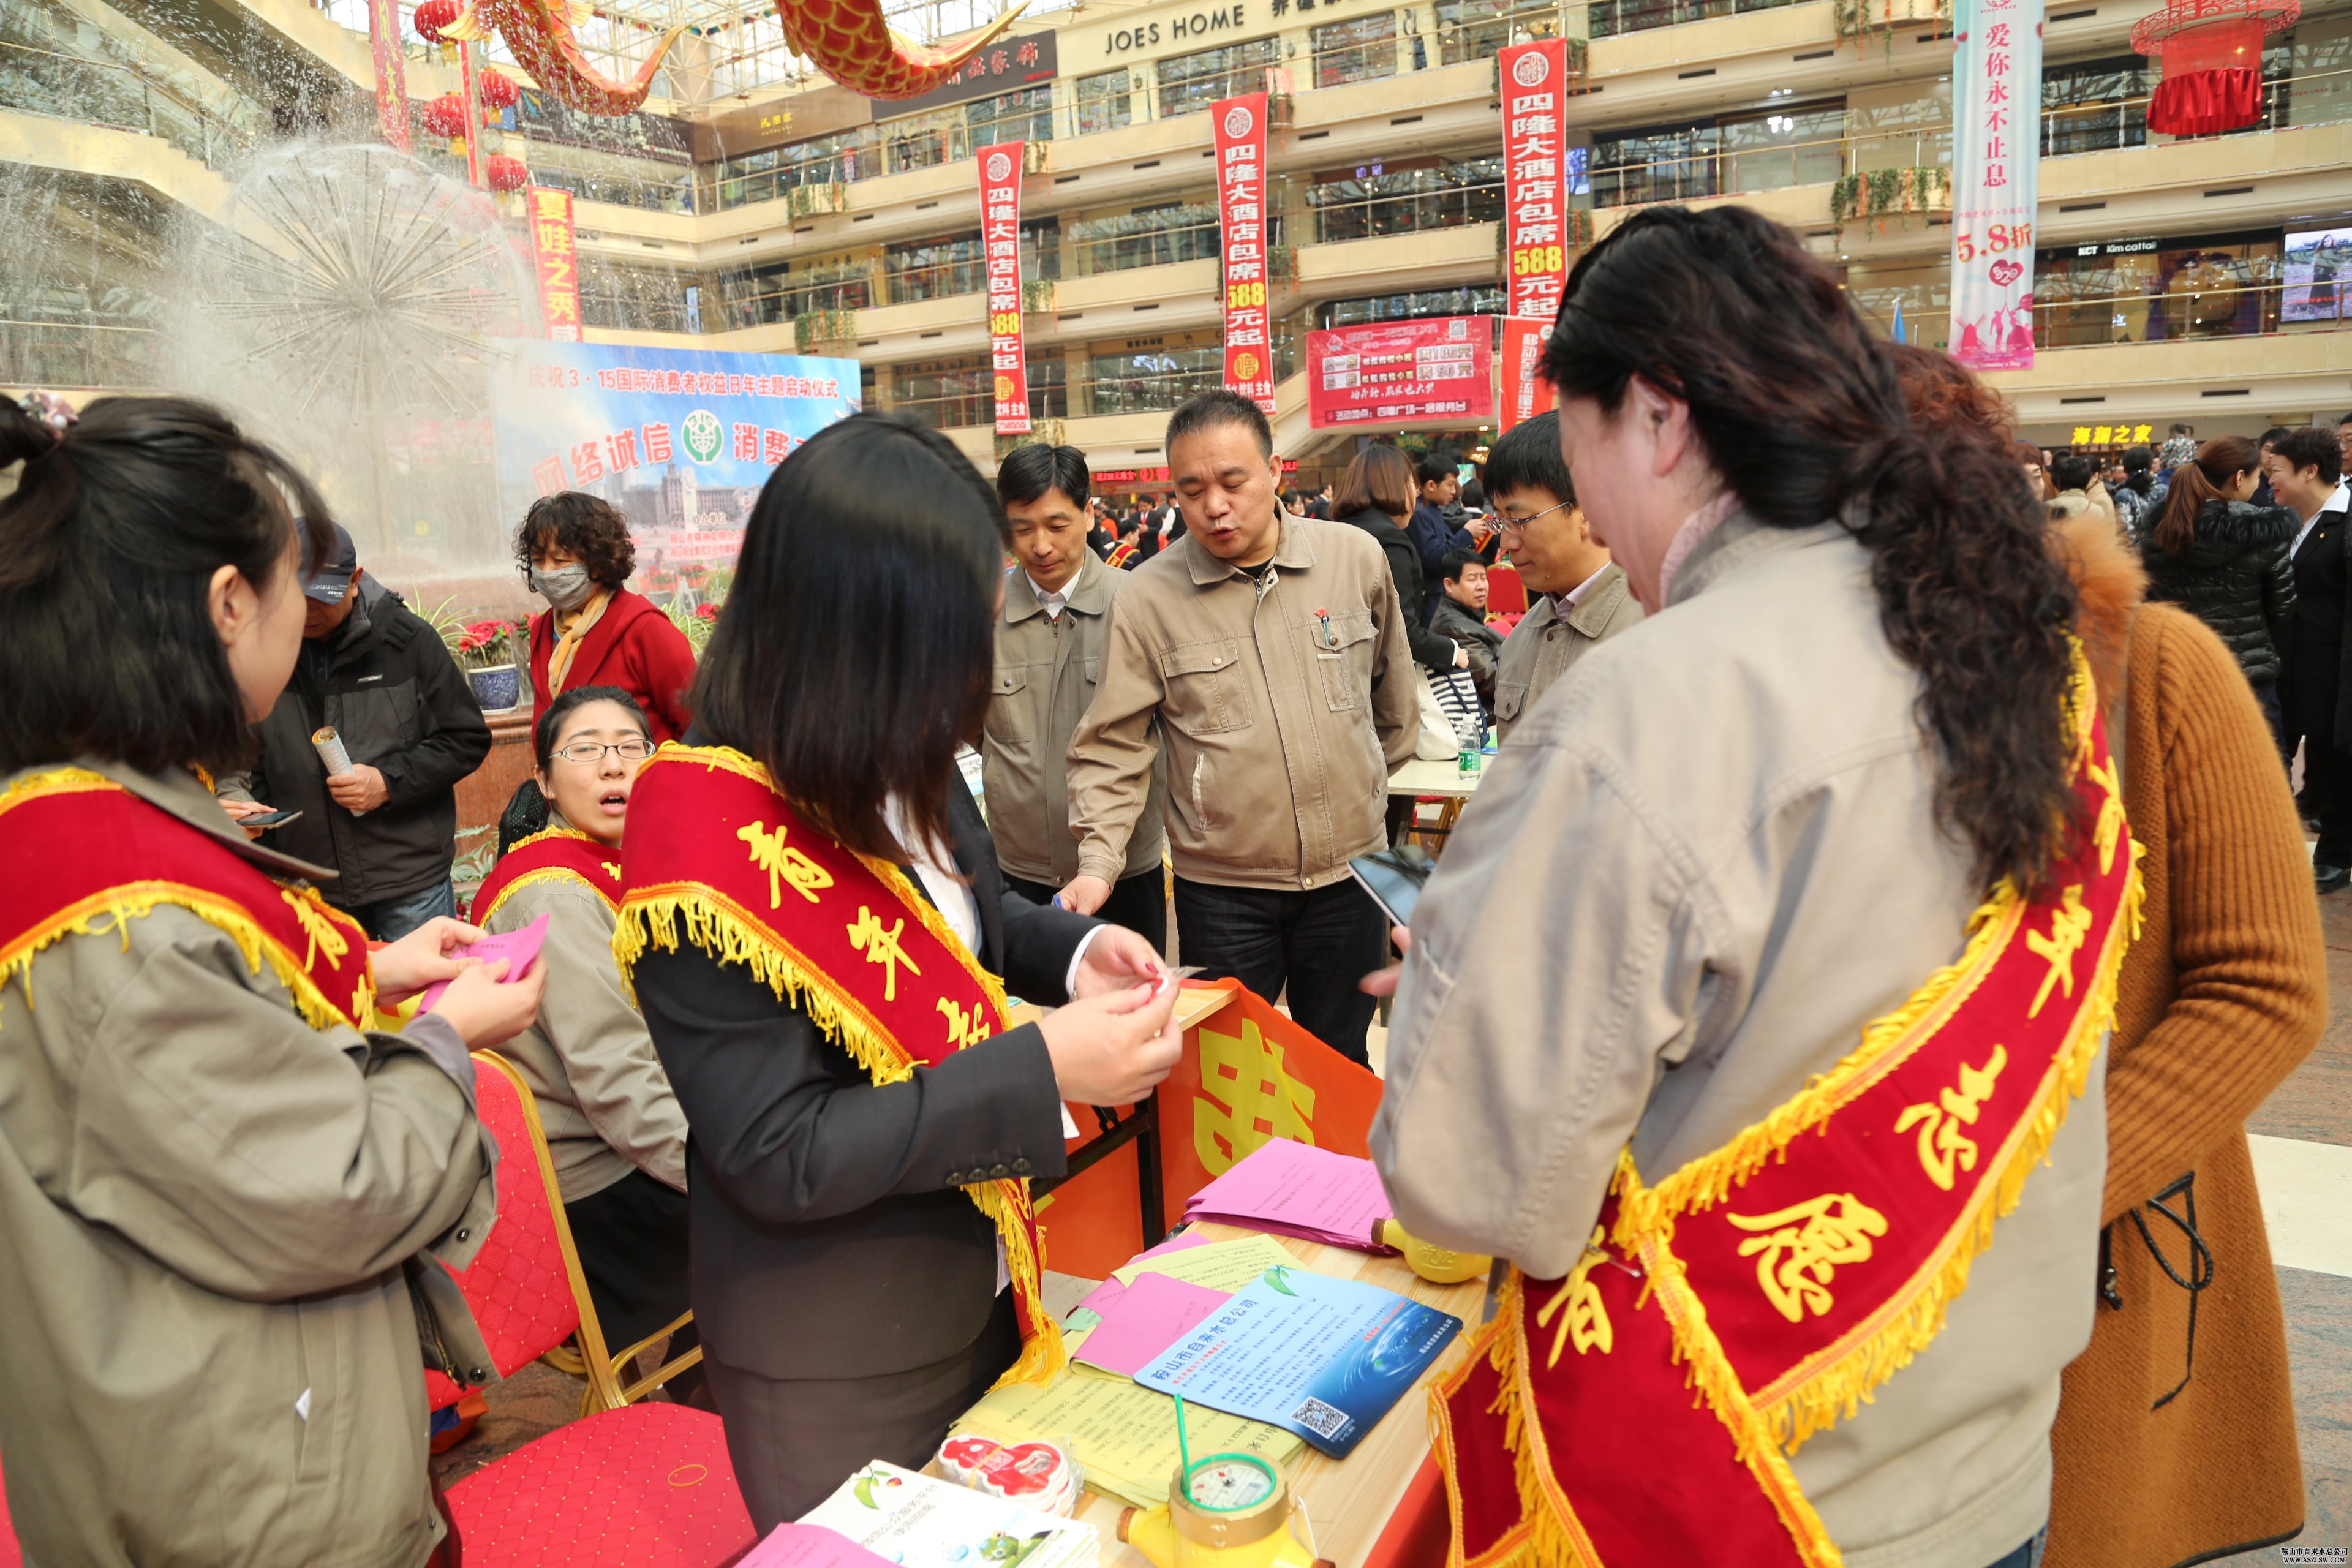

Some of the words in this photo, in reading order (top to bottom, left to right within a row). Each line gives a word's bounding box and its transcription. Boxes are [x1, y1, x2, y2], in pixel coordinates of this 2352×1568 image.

[1106, 23, 1159, 55] JOES
[1173, 4, 1245, 39] HOME
[947, 41, 1039, 85] 品家饰
[1983, 23, 2011, 187] 爱你永不止息
[533, 190, 576, 322] 夏娃之秀
[1957, 222, 2032, 263] 5.8折
[2078, 245, 2099, 257] KCT
[530, 421, 673, 497] 网络诚信
[733, 422, 807, 466] 消费
[2071, 424, 2152, 445] 海澜之家
[1151, 1299, 1259, 1381] 鞍山市自来水总公司
